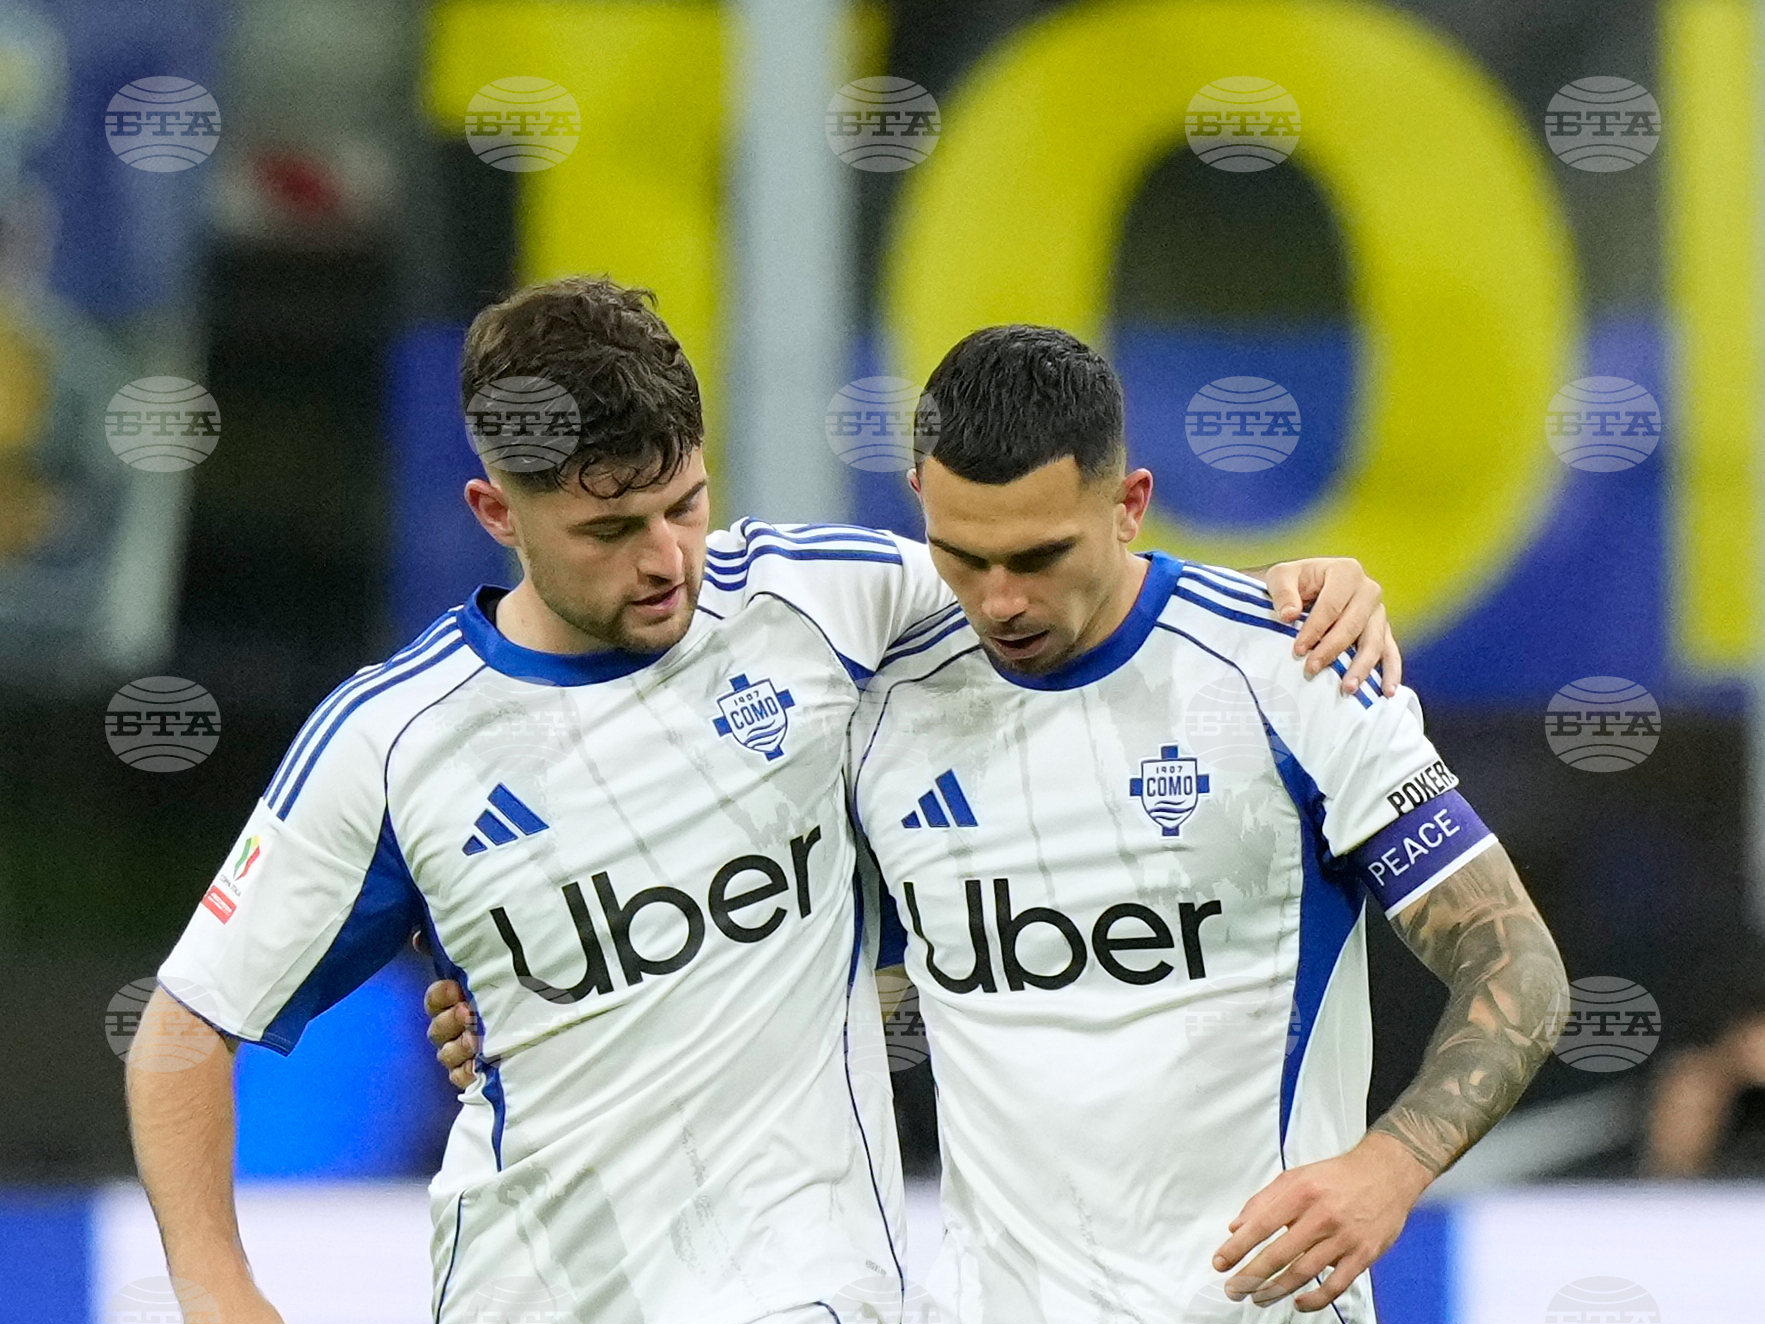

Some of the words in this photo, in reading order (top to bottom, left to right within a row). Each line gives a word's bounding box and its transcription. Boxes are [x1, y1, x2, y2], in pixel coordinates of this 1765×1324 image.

[730, 696, 779, 729] COMO
[1147, 775, 1193, 797] COMO
[1368, 809, 1461, 886] PEACE
[491, 825, 822, 1005] Uber
[903, 877, 1223, 995] Uber
